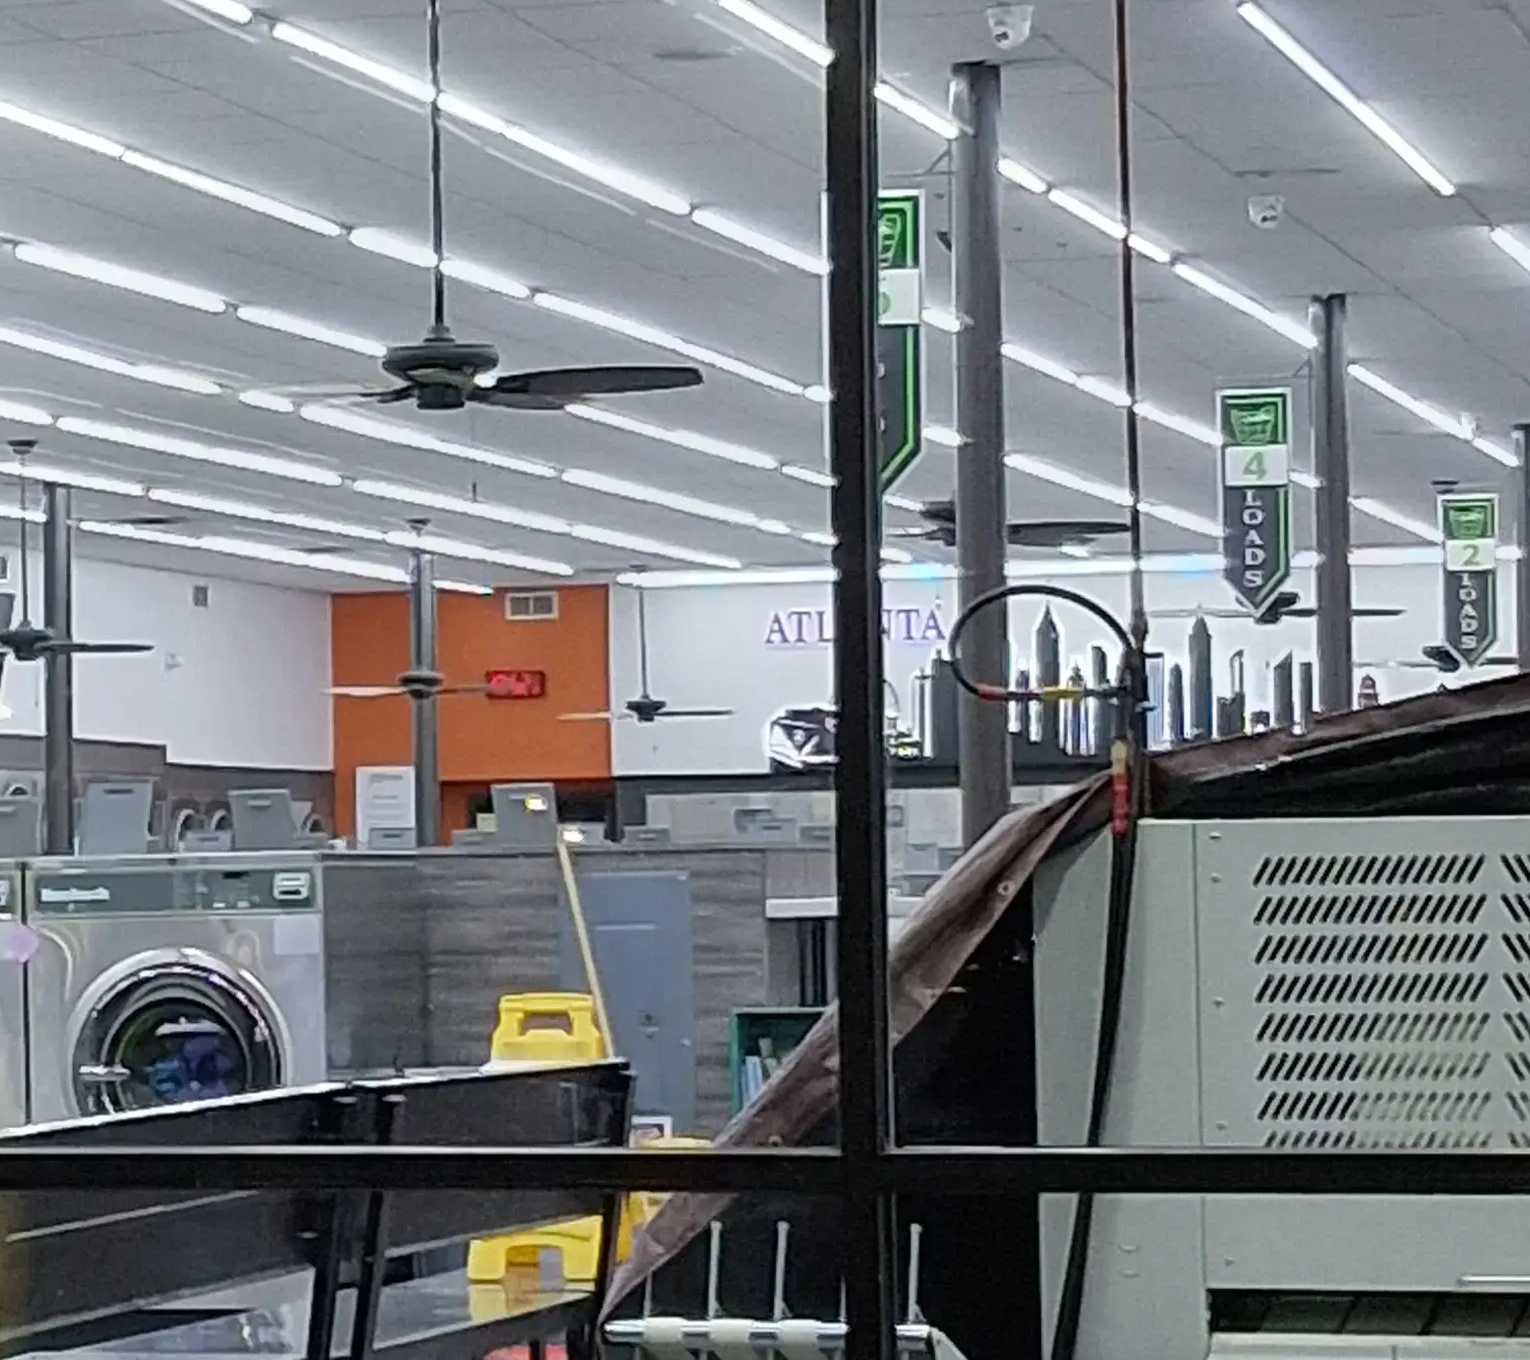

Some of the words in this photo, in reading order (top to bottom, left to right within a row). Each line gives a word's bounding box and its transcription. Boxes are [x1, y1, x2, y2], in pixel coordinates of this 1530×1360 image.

[1241, 451, 1268, 482] 4
[1242, 488, 1267, 589] LOADS
[1459, 544, 1481, 568] 2
[764, 607, 946, 644] ATLTA
